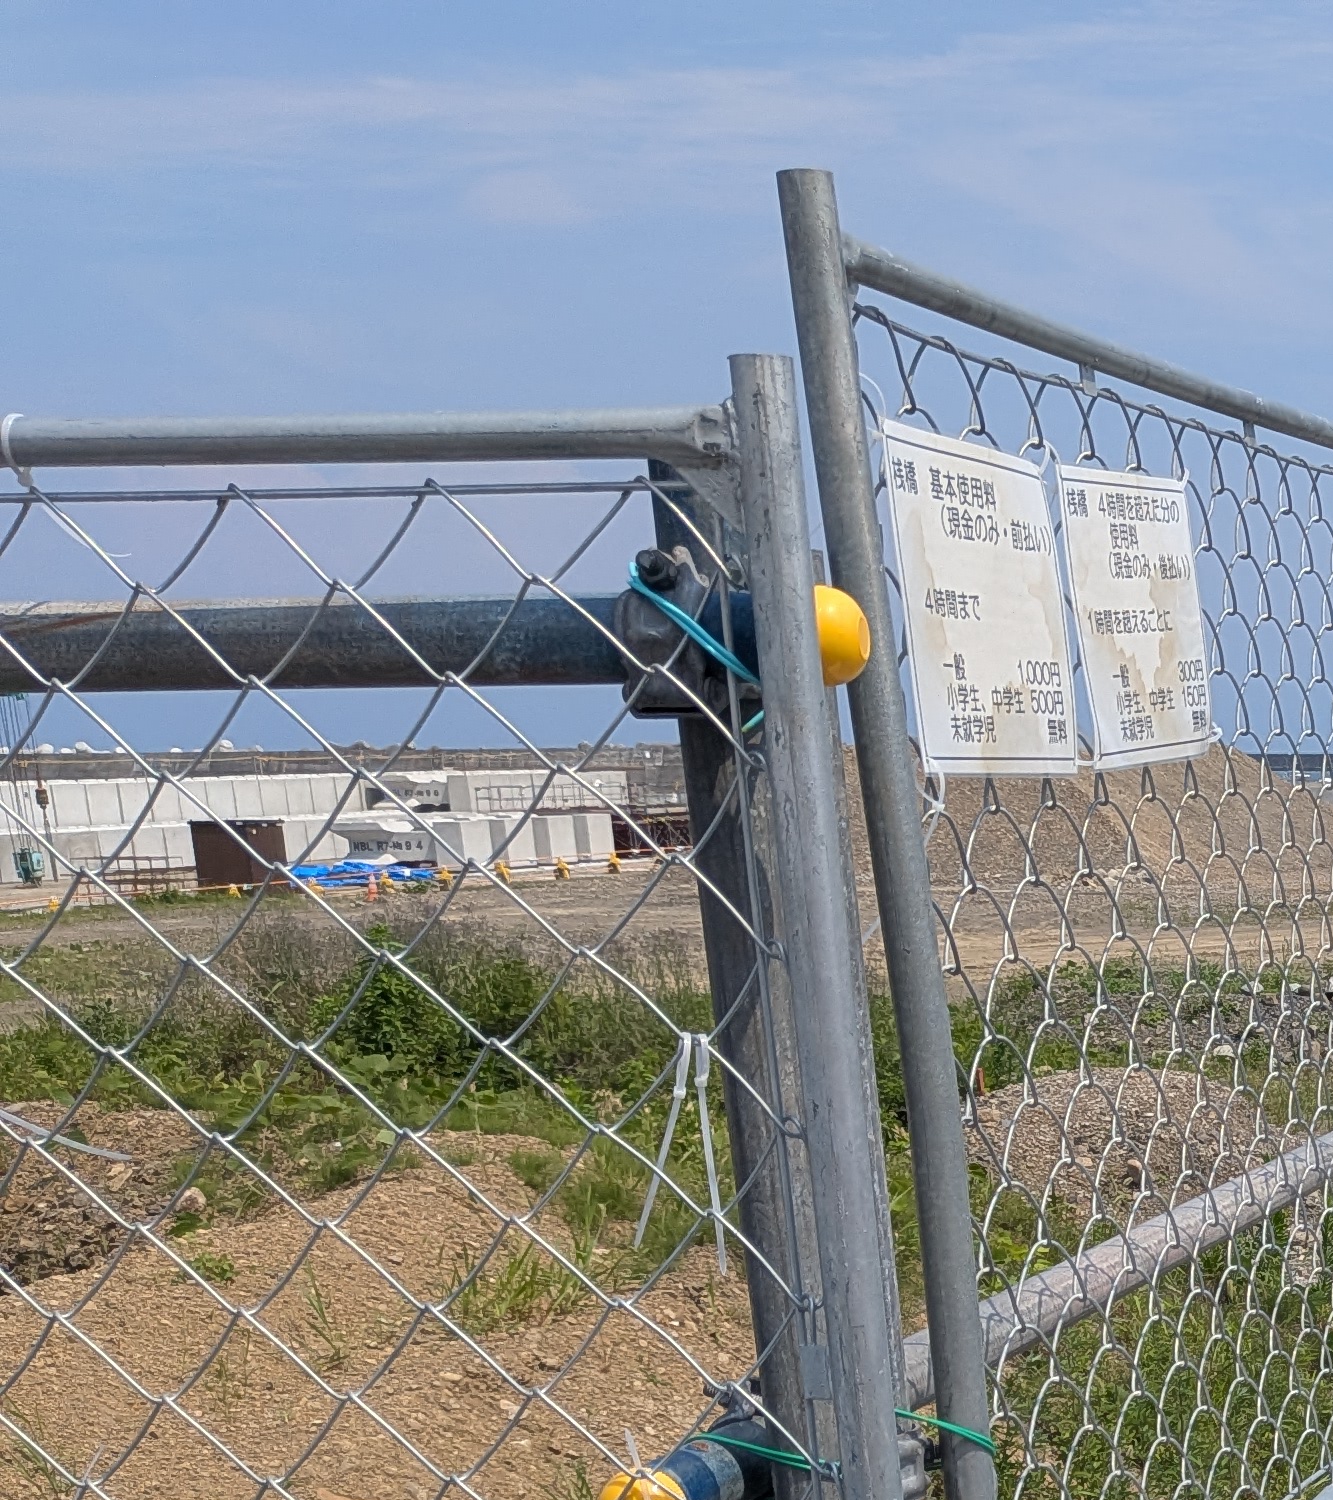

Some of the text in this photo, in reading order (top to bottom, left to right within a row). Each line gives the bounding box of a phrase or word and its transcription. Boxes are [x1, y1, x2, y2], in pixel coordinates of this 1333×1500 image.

[892, 456, 997, 512] 桟橋 基本使用料
[1098, 492, 1180, 523] 4時間を超えた分の
[1110, 522, 1139, 550] 使用料
[925, 588, 981, 621] 4時間まで
[1087, 608, 1173, 635] 1時間を超えるごとに
[943, 652, 1062, 688] 一般 1,000円
[1112, 659, 1204, 688] 一般 300円
[1031, 690, 1065, 716] 500円
[1182, 684, 1207, 707] 150円
[951, 714, 1068, 745] 未就学児 無料
[1120, 709, 1207, 742] 未就学児 無料
